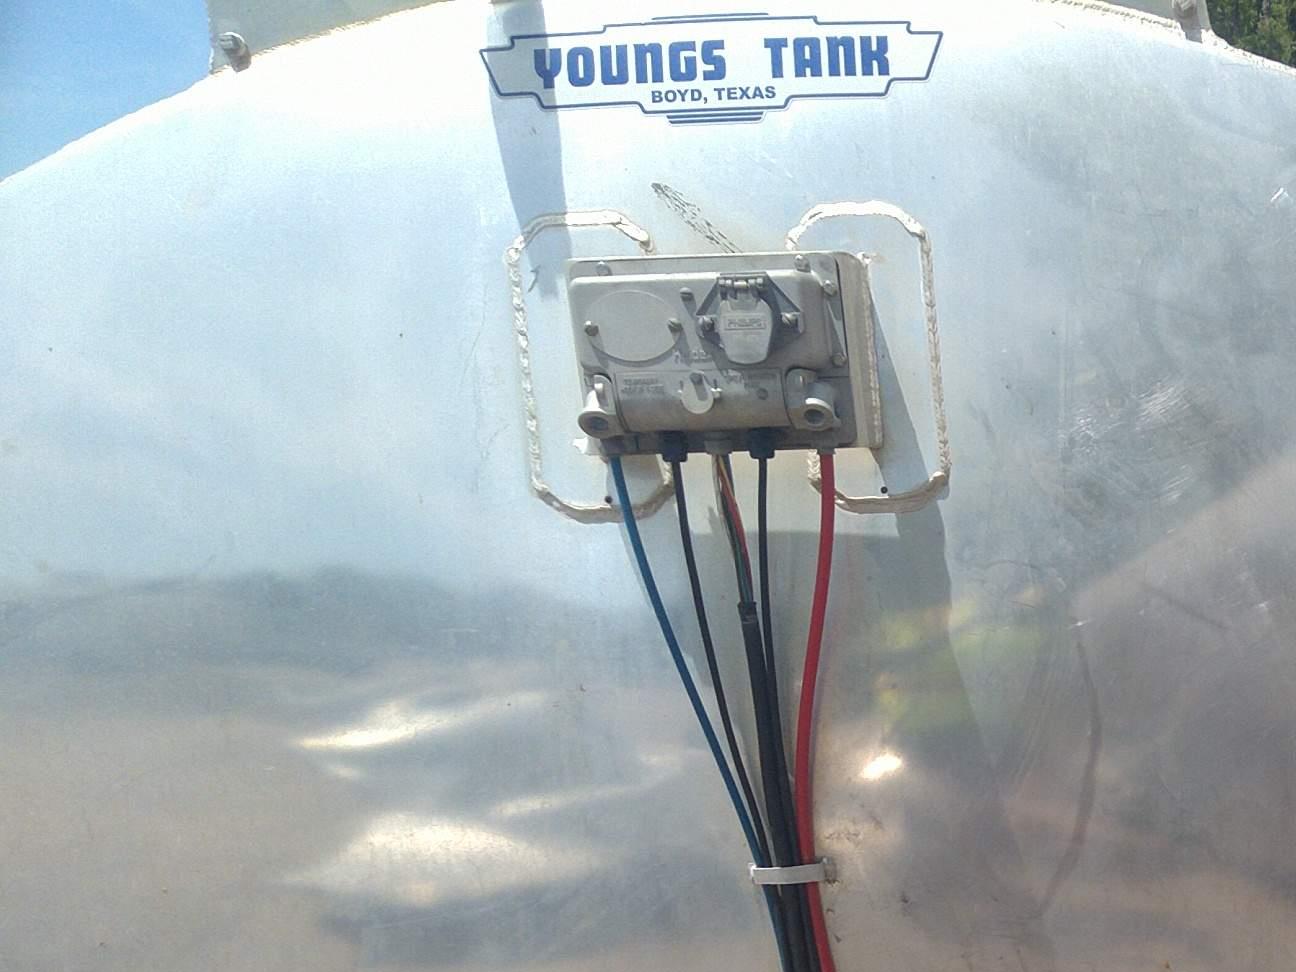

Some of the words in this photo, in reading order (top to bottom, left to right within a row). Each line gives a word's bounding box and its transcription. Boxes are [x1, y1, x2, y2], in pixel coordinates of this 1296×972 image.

[533, 39, 726, 90] YOUNGS
[763, 35, 891, 79] TANK
[651, 89, 708, 105] BOYD,
[714, 85, 776, 101] TEXAS
